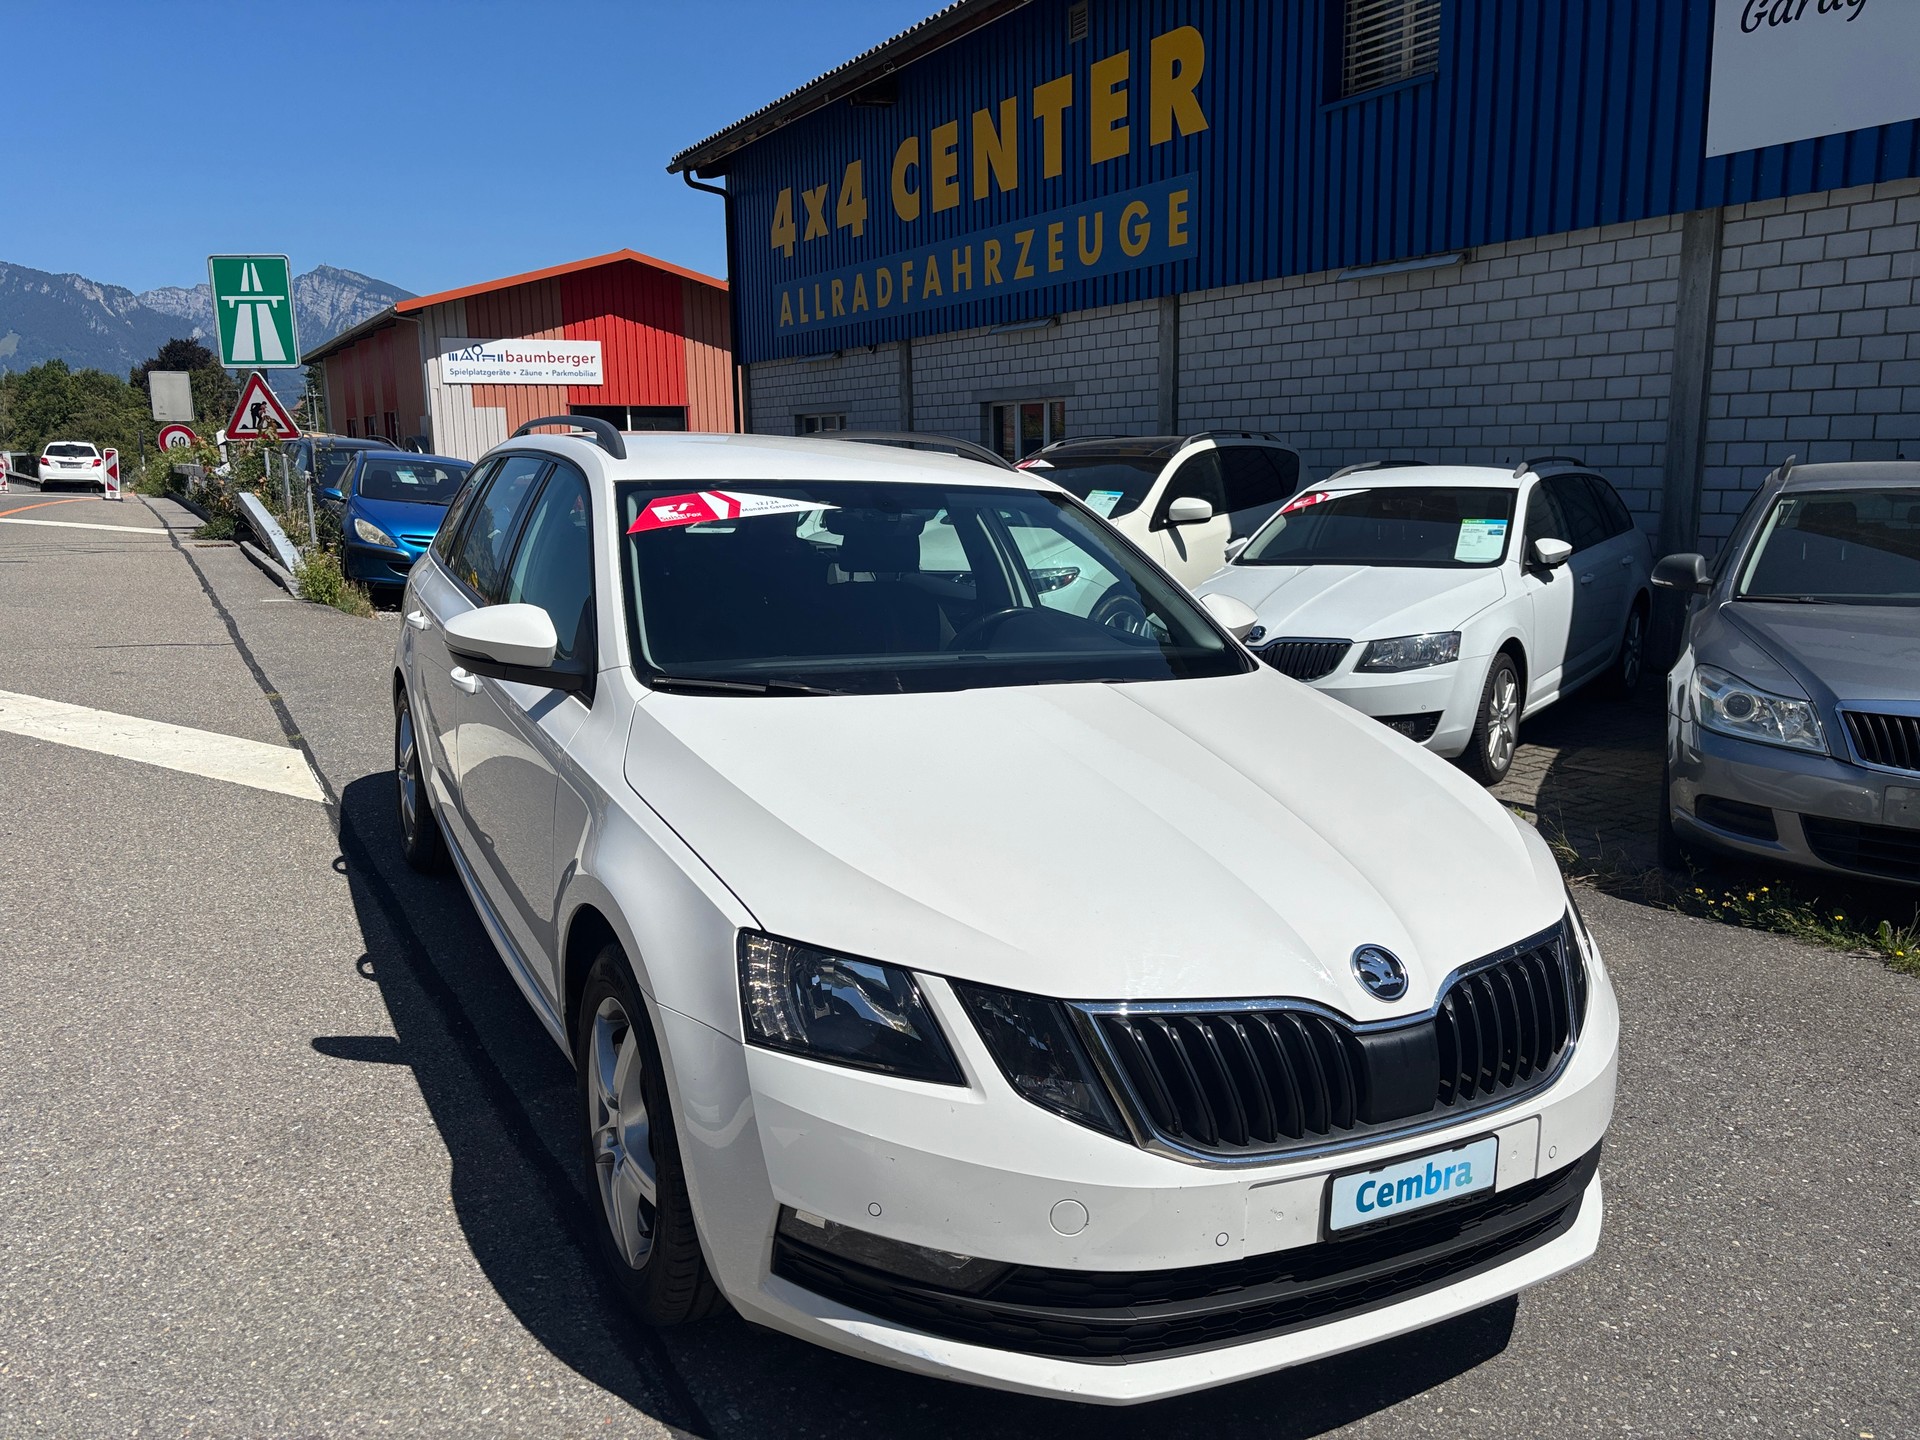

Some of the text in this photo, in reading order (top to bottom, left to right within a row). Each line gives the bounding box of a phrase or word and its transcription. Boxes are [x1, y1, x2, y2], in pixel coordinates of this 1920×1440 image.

[771, 25, 1209, 258] 4x4 CENTER
[779, 189, 1189, 328] ALLRADFAHRZEUGE
[449, 368, 511, 377] Spielplatzgeräte
[519, 369, 543, 377] Zäune
[505, 350, 596, 367] baumberger
[171, 436, 186, 448] 60
[1356, 1161, 1473, 1213] Cembra
